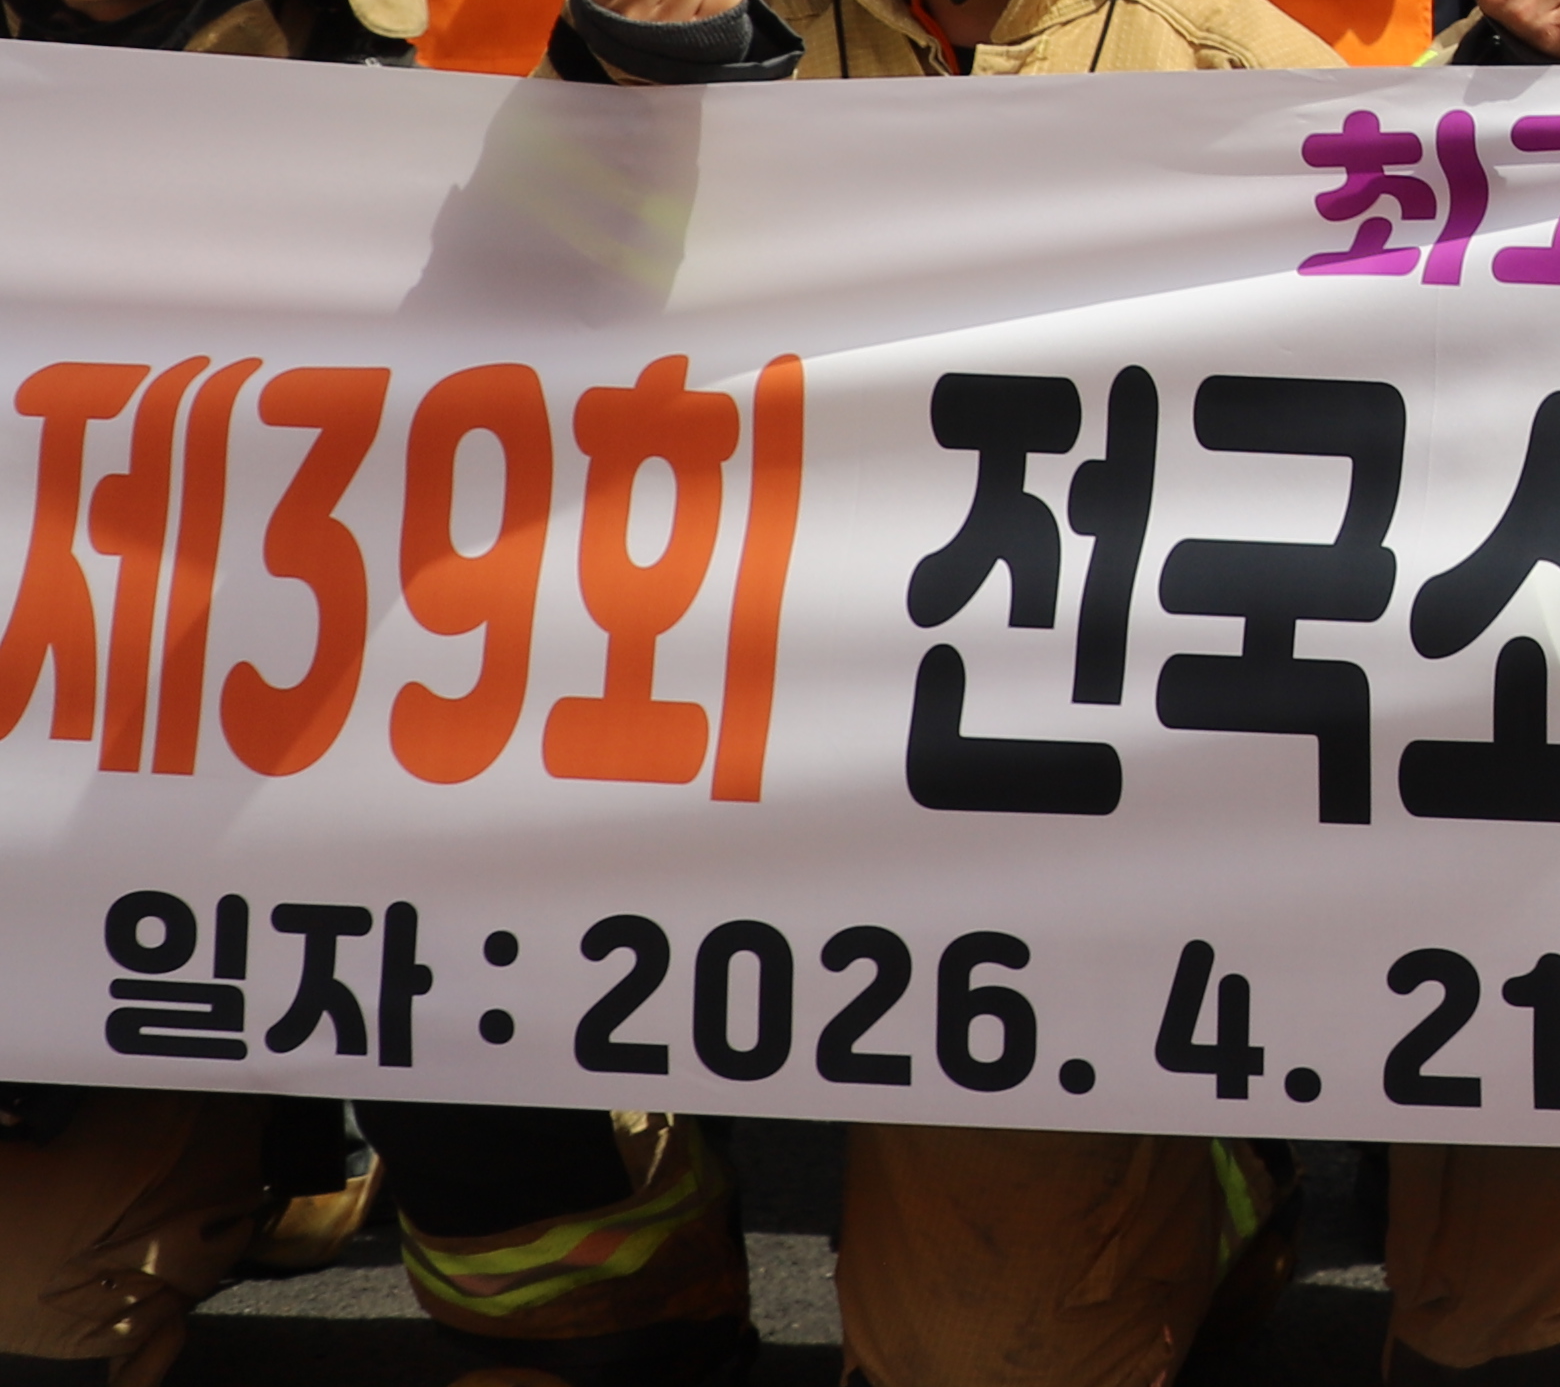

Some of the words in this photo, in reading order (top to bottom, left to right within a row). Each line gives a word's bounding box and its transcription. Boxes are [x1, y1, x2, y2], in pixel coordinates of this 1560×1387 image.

[0, 354, 805, 803] 제39회
[104, 890, 434, 1069] 일자
[573, 914, 1096, 1095] 2026.
[1154, 939, 1322, 1104] 4.
